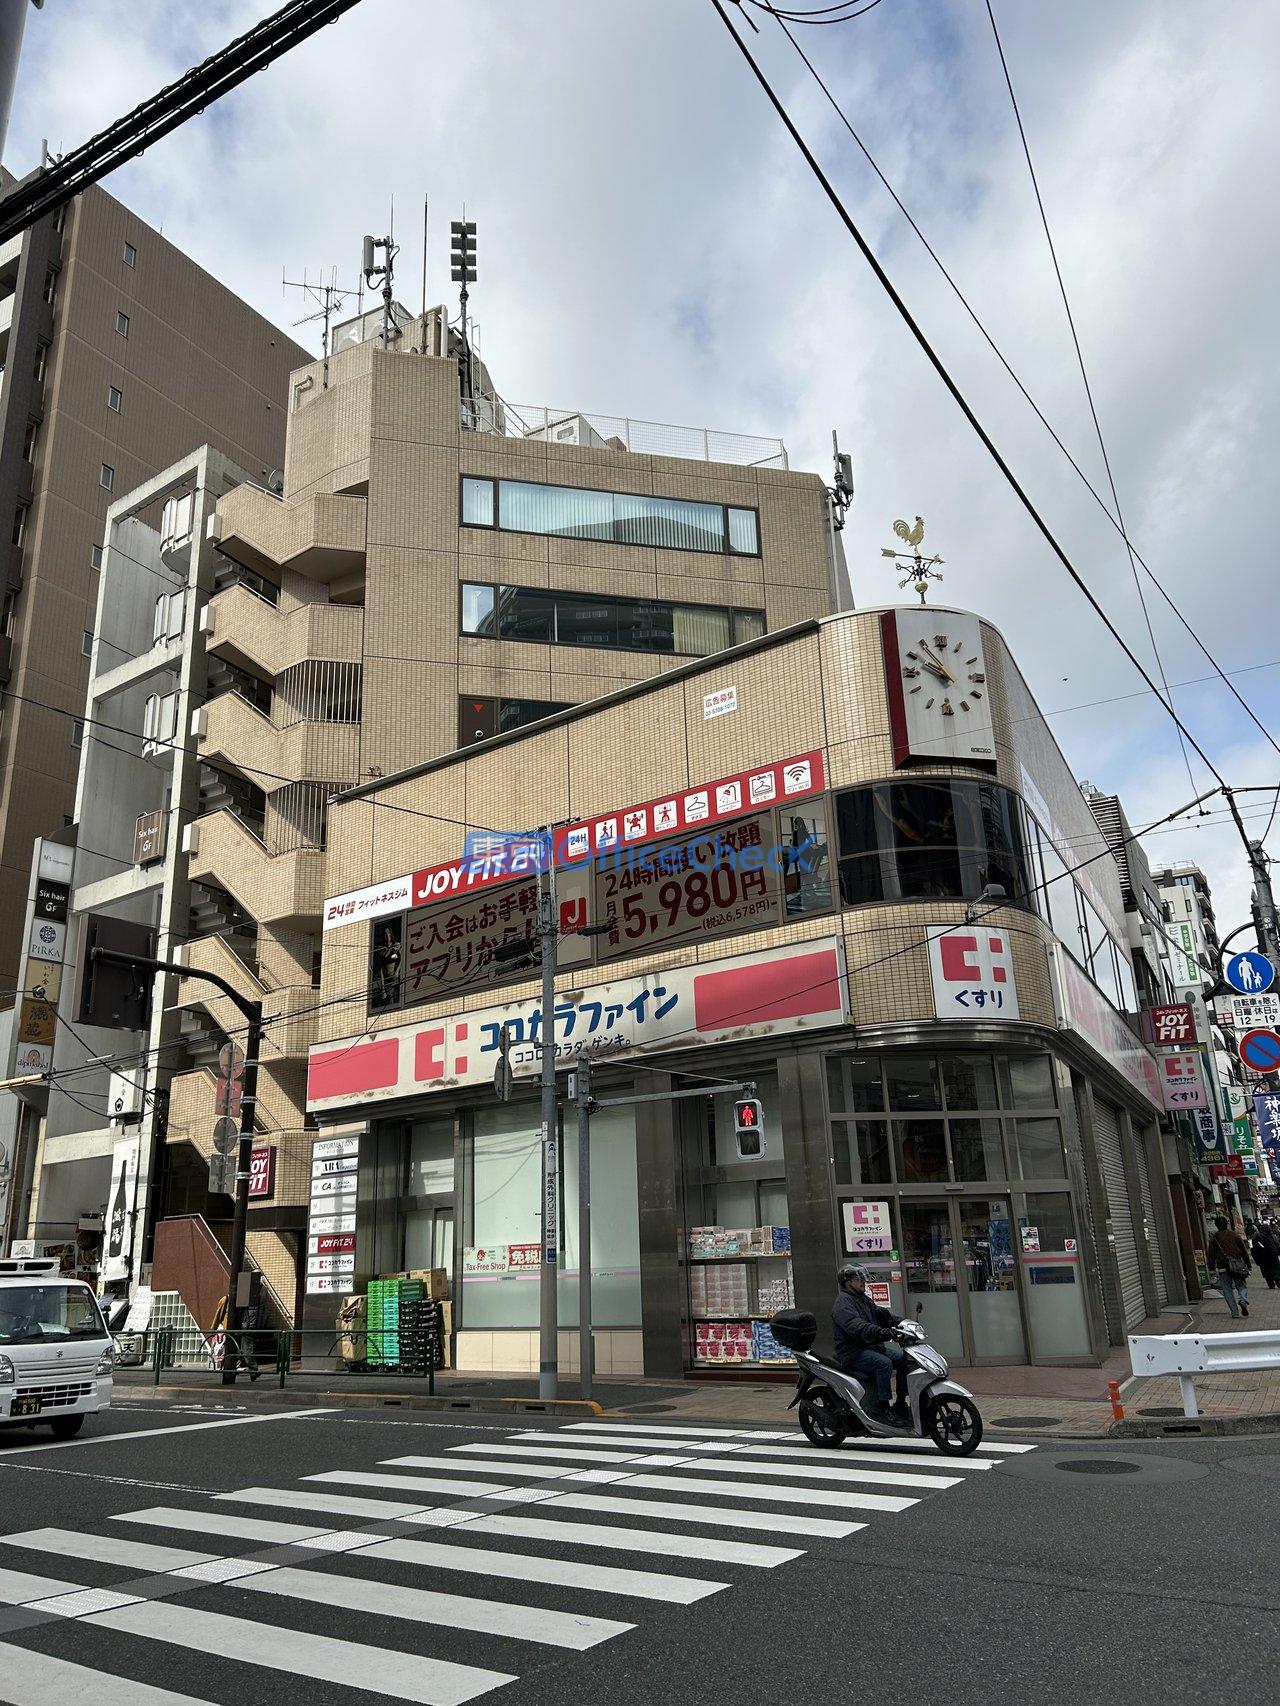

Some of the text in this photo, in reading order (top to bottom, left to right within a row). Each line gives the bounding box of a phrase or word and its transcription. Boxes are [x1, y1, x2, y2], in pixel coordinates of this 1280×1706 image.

[138, 826, 158, 839] Six hair
[570, 833, 587, 845] 24H
[39, 889, 65, 901] Six hair
[358, 888, 408, 910] フィットネスジム
[45, 902, 57, 913] 6F
[954, 989, 1003, 1009] くすり
[1233, 997, 1278, 1007] 自転車を除く
[479, 986, 679, 1053] ココカラファイン
[1155, 1013, 1188, 1027] JOY
[1159, 1025, 1190, 1040] FIT
[1170, 1090, 1199, 1102] くすり
[856, 1238, 883, 1250] くすり
[466, 1260, 506, 1272] Tax-Free Shop
